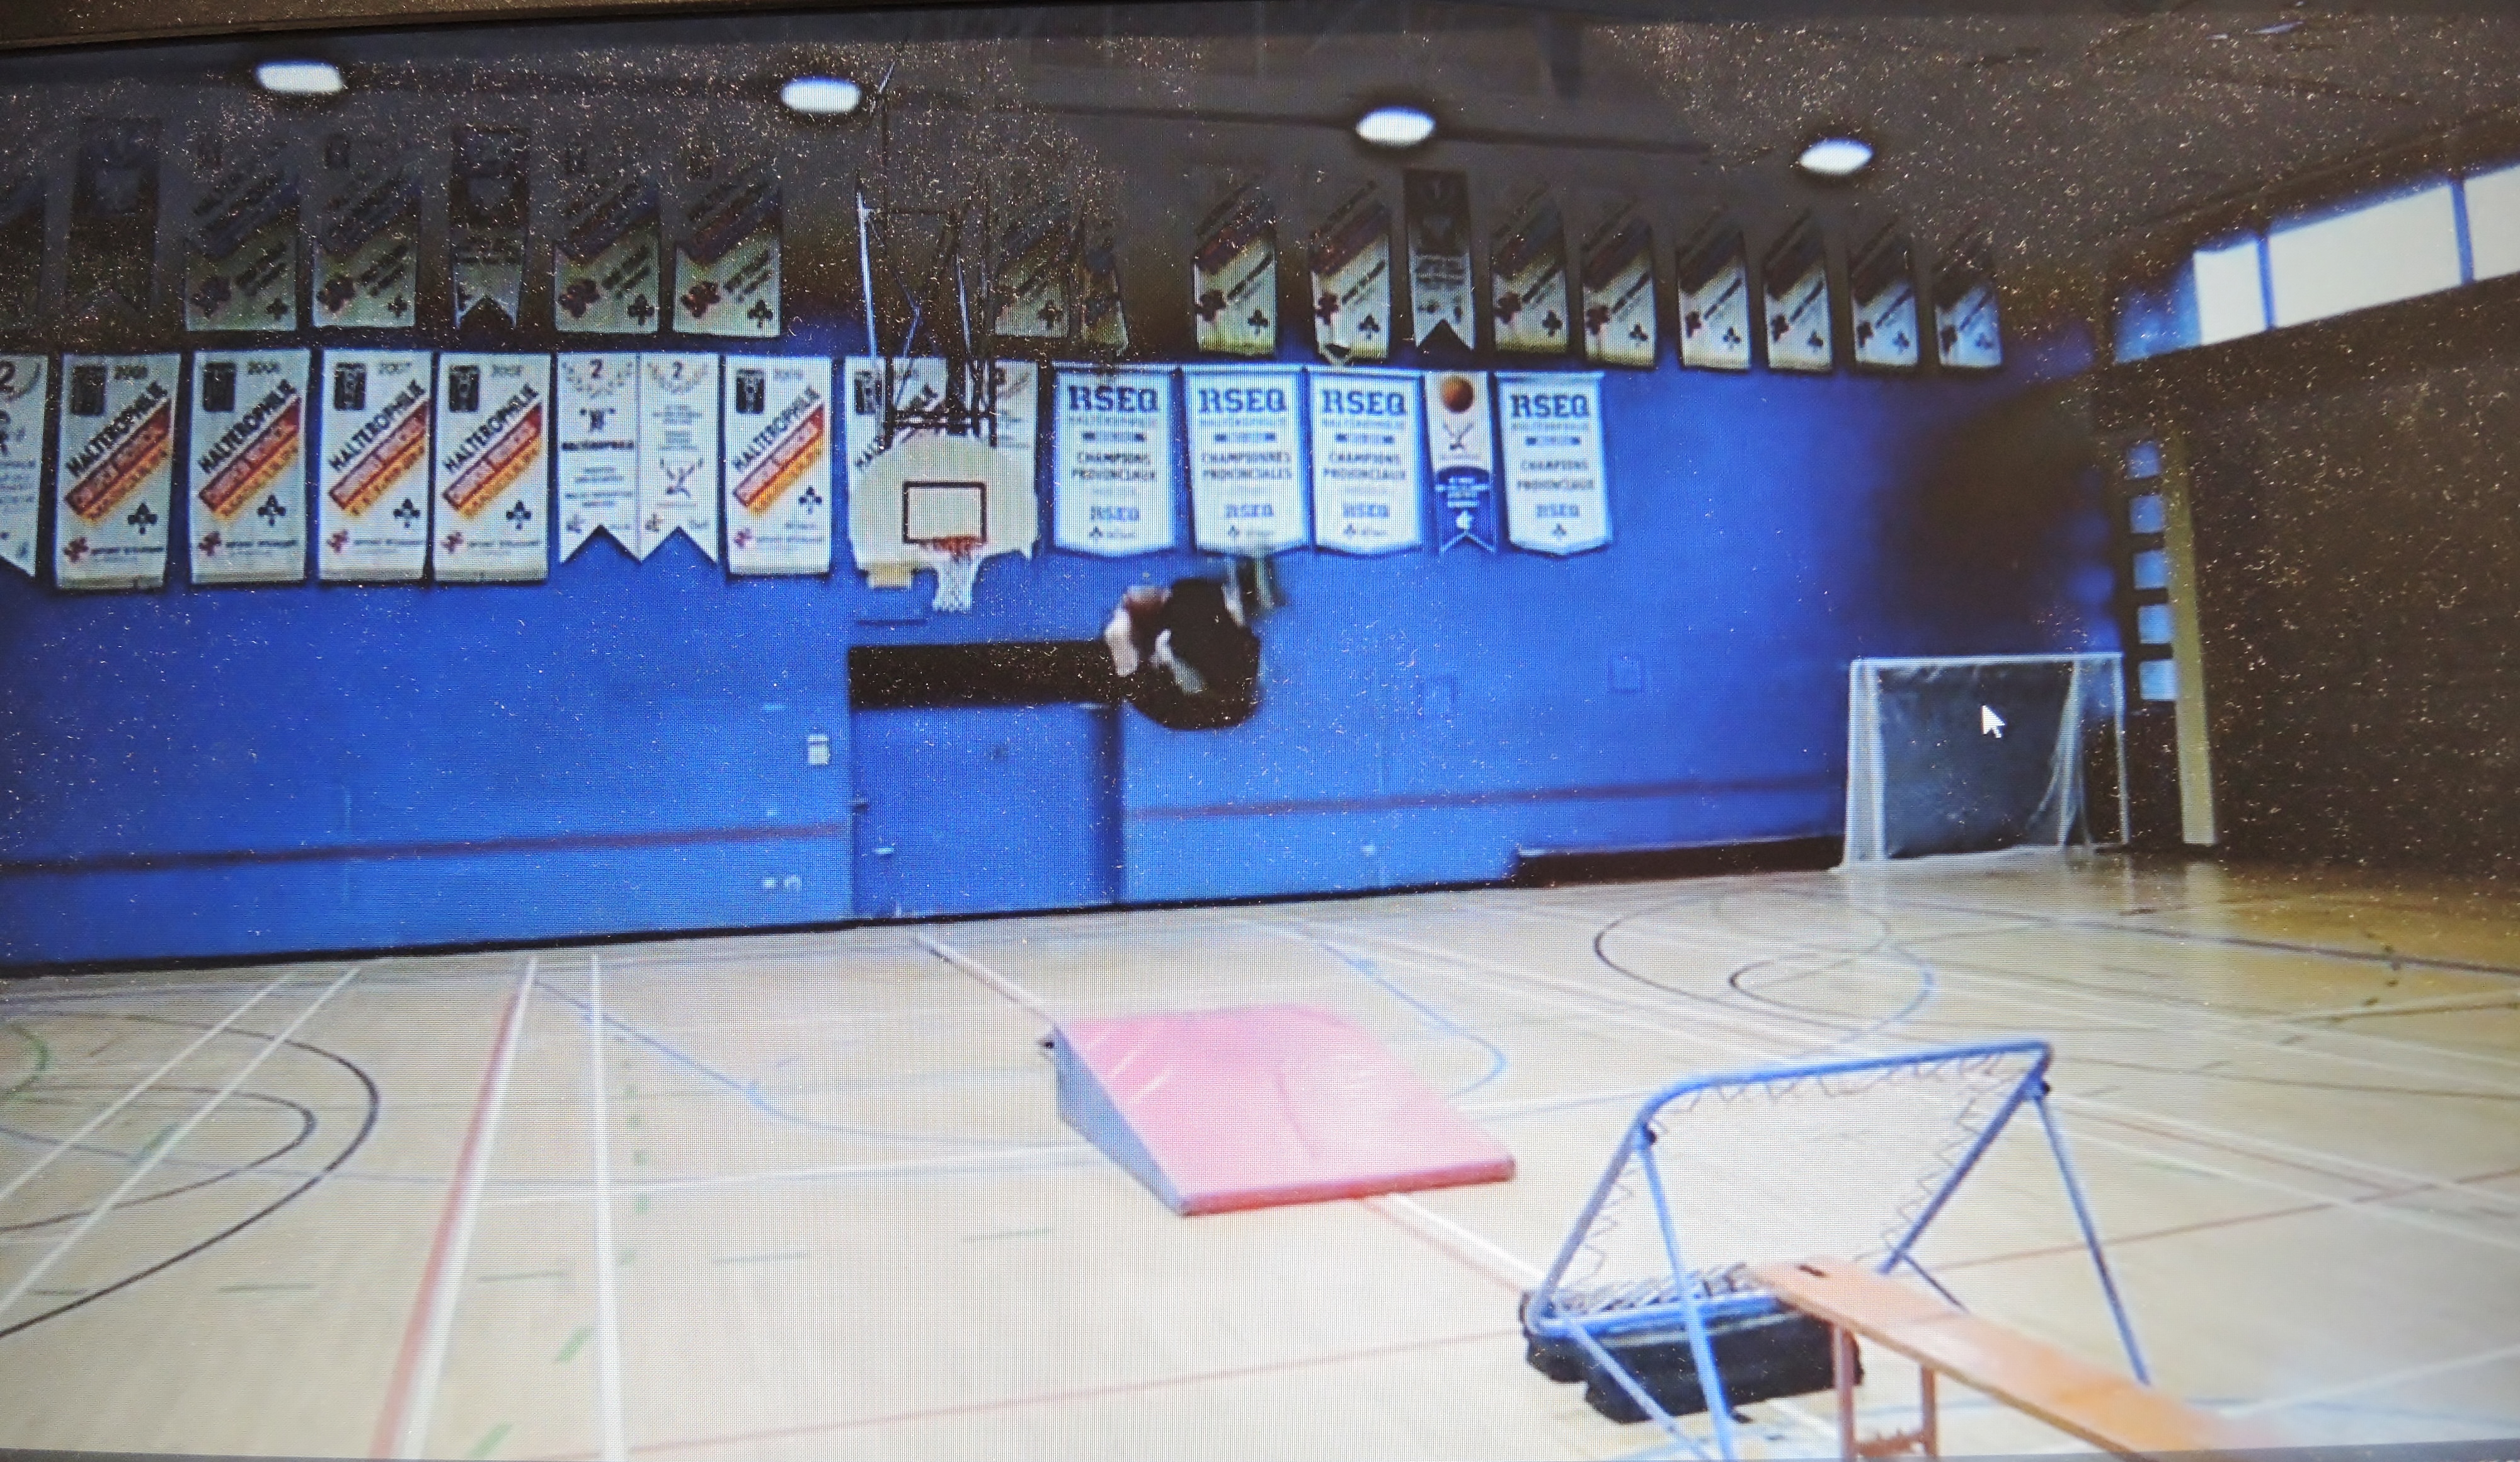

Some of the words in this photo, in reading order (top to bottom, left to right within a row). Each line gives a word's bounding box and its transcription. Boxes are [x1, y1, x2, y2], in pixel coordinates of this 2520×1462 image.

[590, 359, 604, 378] 2
[1068, 385, 1158, 412] RSEQ
[1198, 388, 1287, 413] RSEQ
[1322, 389, 1406, 415] RSEQ
[1510, 394, 1589, 417] RSEQ
[198, 378, 296, 473] HALTEROPHILIE
[329, 379, 425, 471] HALTEROPHILIE
[445, 383, 539, 473] HALTEROPHILIE
[732, 386, 822, 471] HALTEROPHILIE
[1329, 452, 1401, 465] CHAMPIONS
